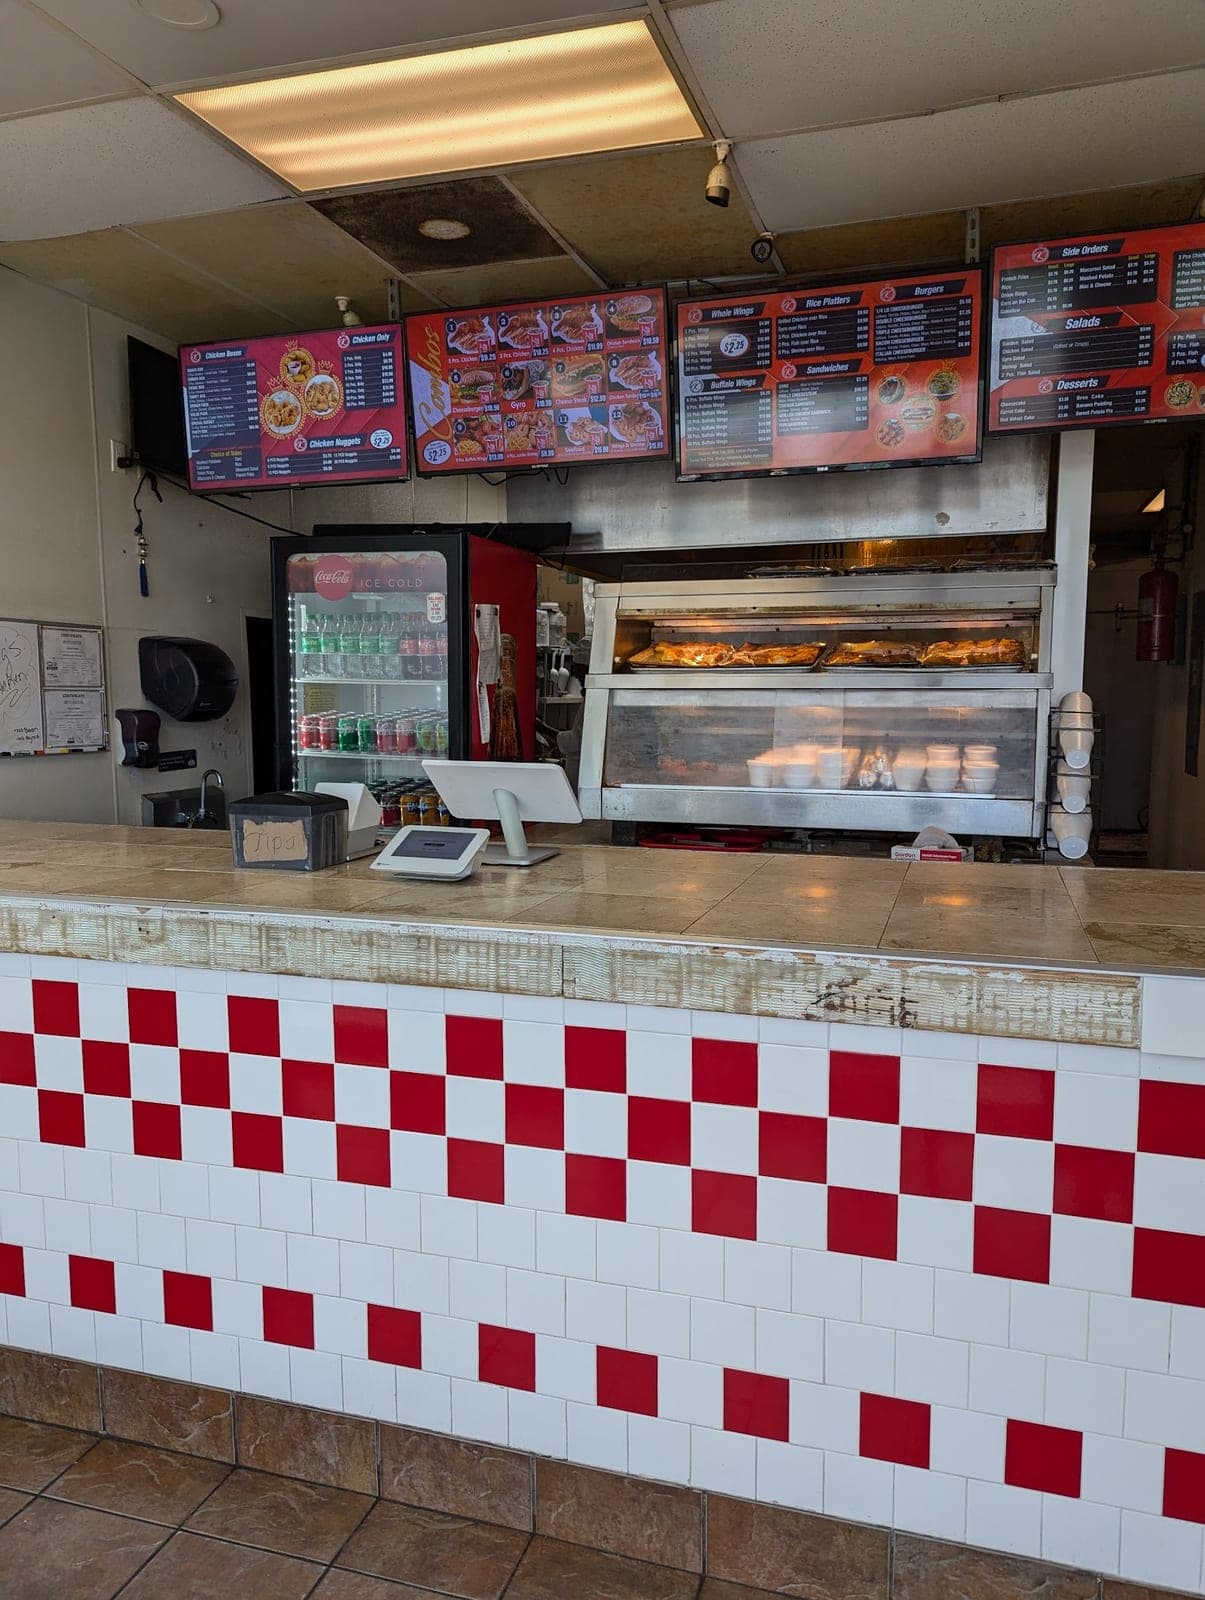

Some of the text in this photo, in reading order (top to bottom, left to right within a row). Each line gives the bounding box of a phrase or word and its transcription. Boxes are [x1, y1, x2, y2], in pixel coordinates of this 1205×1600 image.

[1062, 244, 1109, 257] Side Orders
[914, 286, 944, 296] Burgers
[806, 296, 851, 308] Rice Platters
[890, 304, 923, 312] CHEESEBURGER
[711, 307, 754, 319] Whole Wings
[893, 314, 927, 322] CHEESEBURGER
[1065, 316, 1101, 329] Salads
[352, 331, 390, 344] Chicken Only
[724, 341, 744, 354] $2.25
[893, 347, 926, 355] CHEESEBURGER
[205, 351, 225, 360] Chicken
[806, 364, 849, 374] Sandwiches
[417, 323, 452, 440] Combos
[711, 379, 756, 389] Buffalo Wings
[1057, 378, 1099, 390] Desserts
[510, 402, 526, 410] Gyro
[309, 437, 361, 449] Chicken Nuggets
[429, 448, 447, 461] $2.25
[315, 570, 349, 584] Coca-Cola
[361, 579, 423, 588] ICE COLD
[246, 832, 296, 855] Tips
